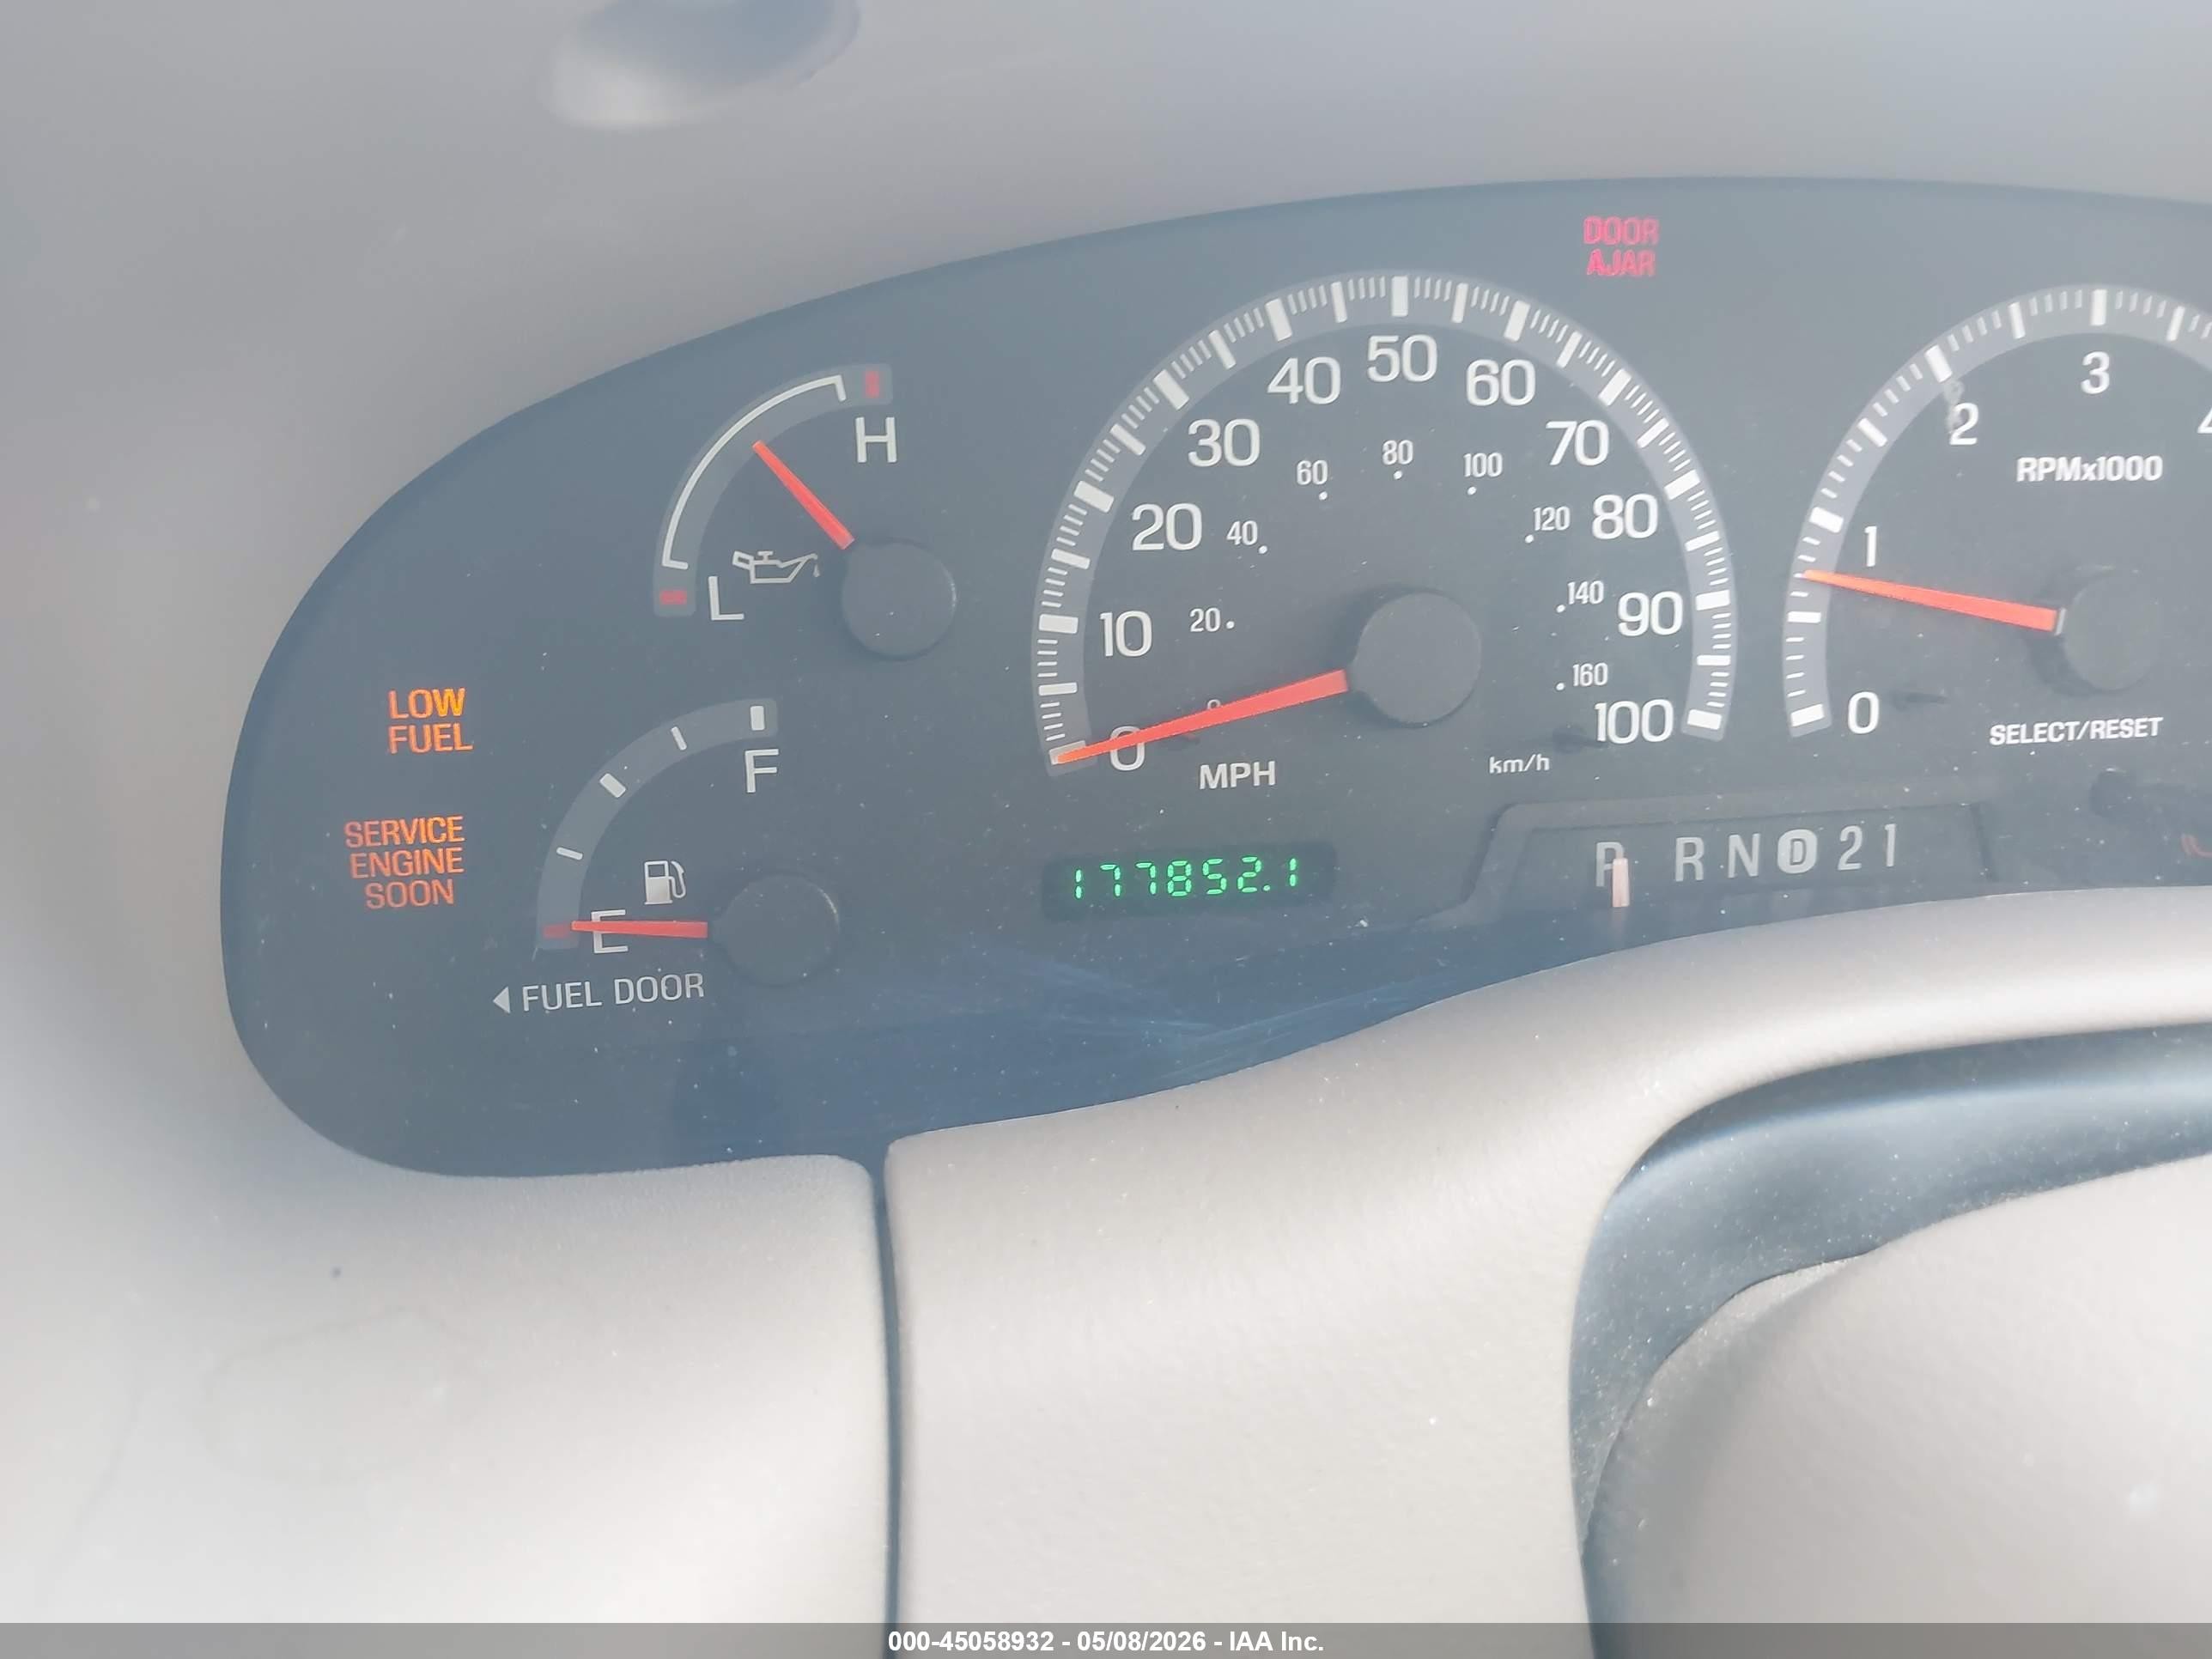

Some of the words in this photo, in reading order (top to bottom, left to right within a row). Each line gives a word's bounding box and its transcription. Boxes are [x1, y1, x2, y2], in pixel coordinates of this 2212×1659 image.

[1583, 216, 1659, 245] DOOR
[1586, 248, 1656, 276] AJAR
[1368, 335, 1437, 383] 50
[2081, 351, 2110, 394] 3
[1268, 357, 1341, 404] 40
[1466, 359, 1535, 405] 60
[855, 416, 896, 463] H
[1188, 419, 1261, 467] 30
[1547, 420, 1609, 465] 70
[1949, 402, 1978, 445] 2
[1297, 459, 1328, 485] 60
[1382, 440, 1414, 465] 80
[1463, 452, 1503, 477] 100
[2016, 456, 2163, 482] RPMx1000
[1133, 504, 1203, 550] 20
[1227, 520, 1258, 546] 40
[1533, 506, 1571, 532] 120
[1592, 494, 1658, 540] 80
[1864, 526, 1877, 567] 1
[708, 576, 744, 620] L
[1568, 580, 1604, 605] 140
[1101, 611, 1152, 657] 10
[1189, 609, 1221, 633] 20
[1617, 591, 1683, 637] 90
[1572, 661, 1608, 687] 160
[388, 688, 465, 719] LOW
[1595, 699, 1674, 744] 100
[1847, 692, 1879, 734] 0
[388, 724, 473, 754] FUEL
[1109, 726, 1146, 771] 0
[1989, 717, 2162, 744] SELECT/RESET
[744, 749, 779, 793] F
[1199, 761, 1276, 789] MPH
[1489, 754, 1550, 775] km/h
[344, 816, 464, 848] SERVICE
[349, 848, 464, 878] ENGINE
[1595, 842, 1624, 887] P
[1675, 836, 1704, 882] R
[1728, 833, 1760, 878] N
[1838, 825, 1863, 871] 2
[1885, 823, 1896, 866] 1
[365, 879, 454, 909] SOON
[1075, 856, 1297, 899] 177852.1
[591, 909, 628, 953] E
[522, 981, 601, 1012] FUEL
[614, 972, 704, 1006] DOOR
